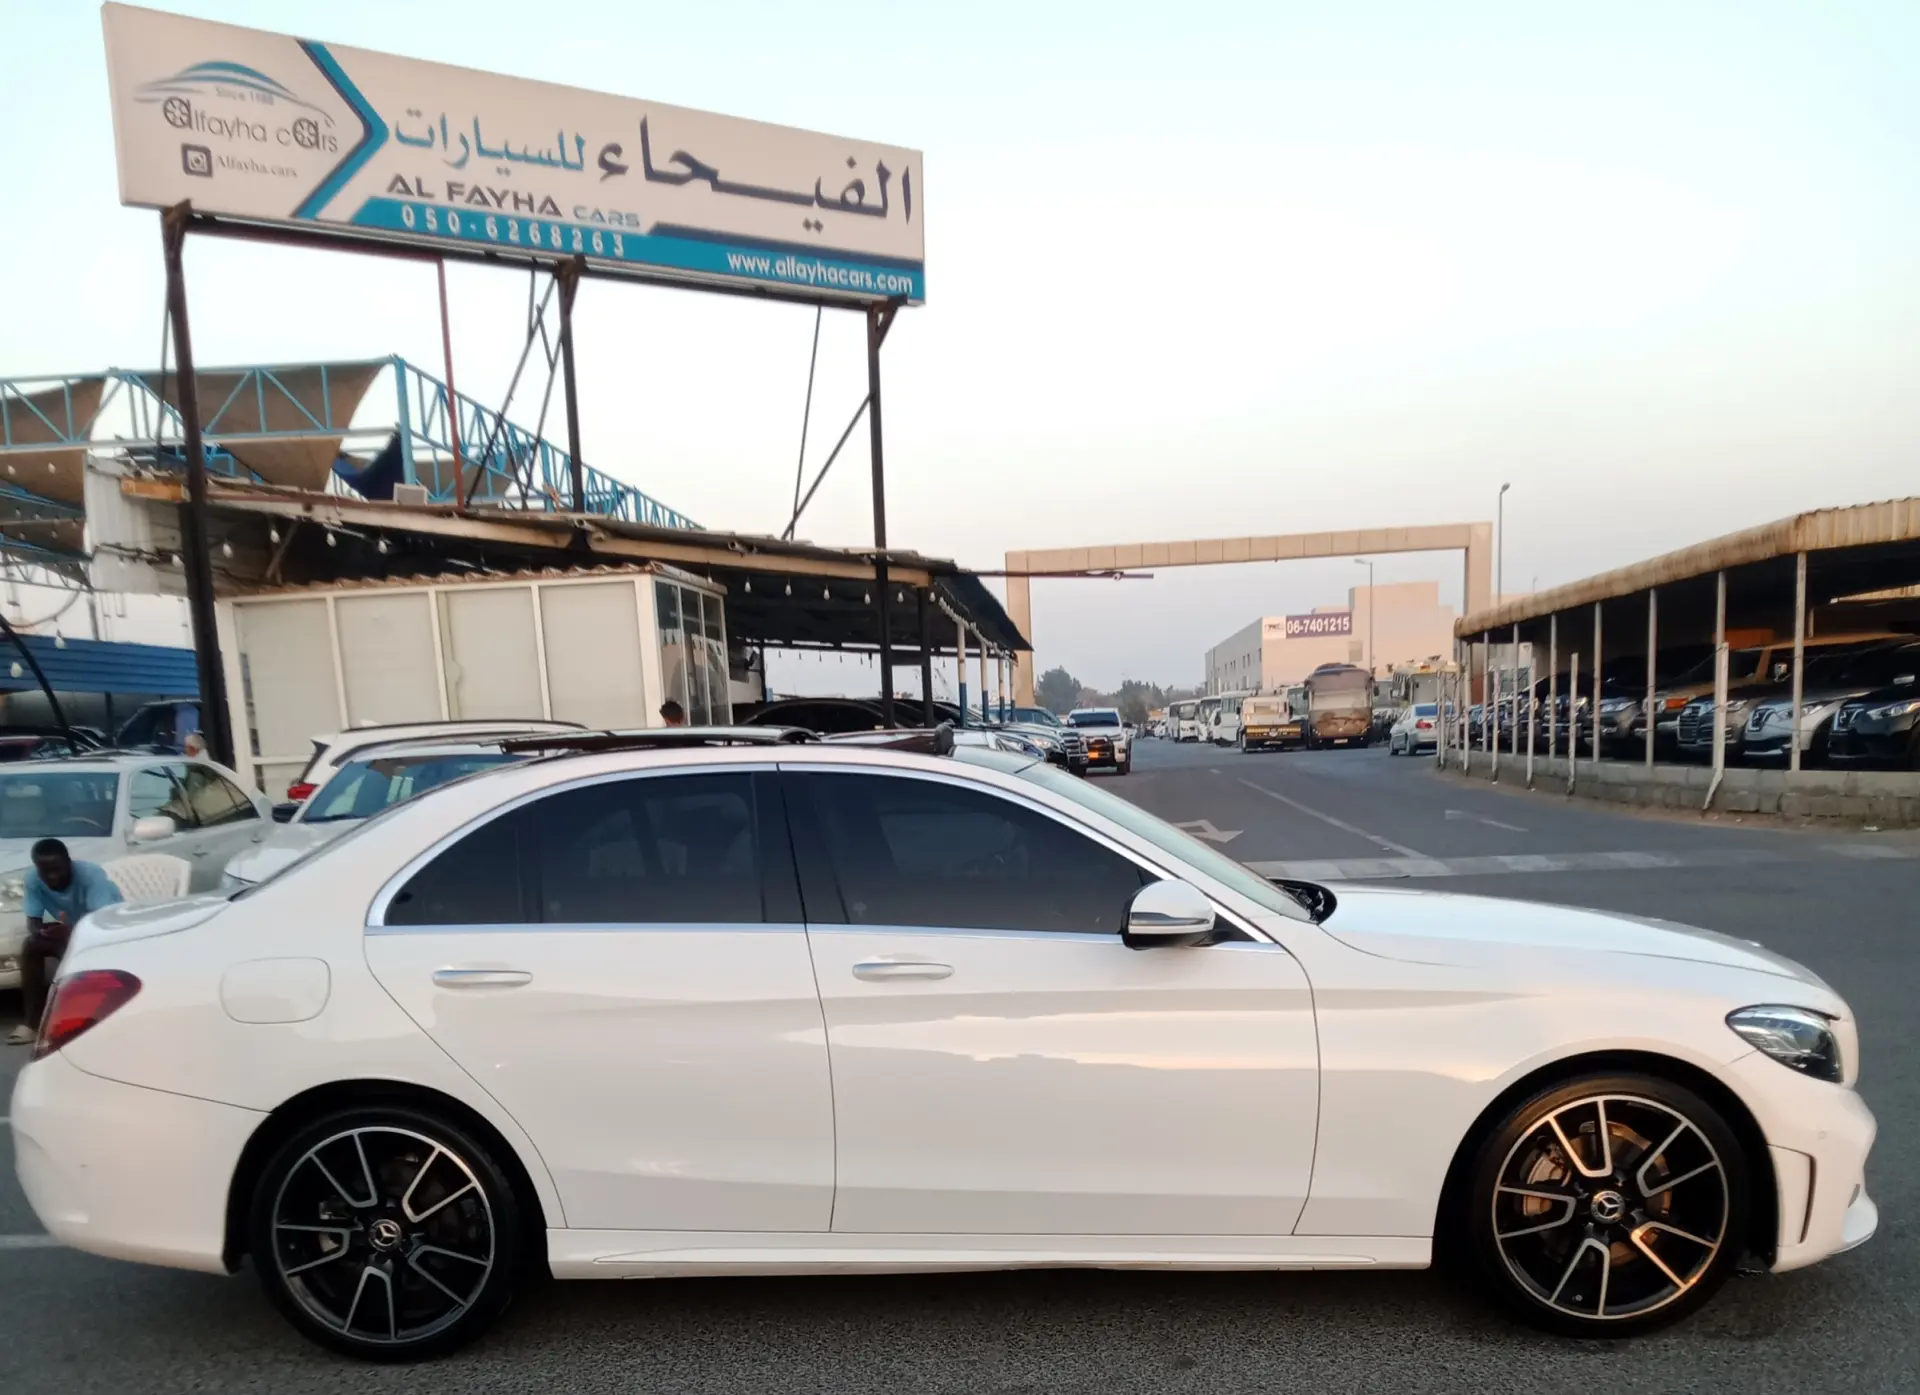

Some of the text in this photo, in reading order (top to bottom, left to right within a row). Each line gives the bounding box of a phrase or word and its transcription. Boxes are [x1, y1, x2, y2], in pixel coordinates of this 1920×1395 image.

[394, 108, 586, 177] للسيارات
[386, 173, 641, 228] AL FAYHA CARS
[727, 252, 913, 295] www.alfayhacars.com
[1286, 616, 1350, 634] 06-7401215
